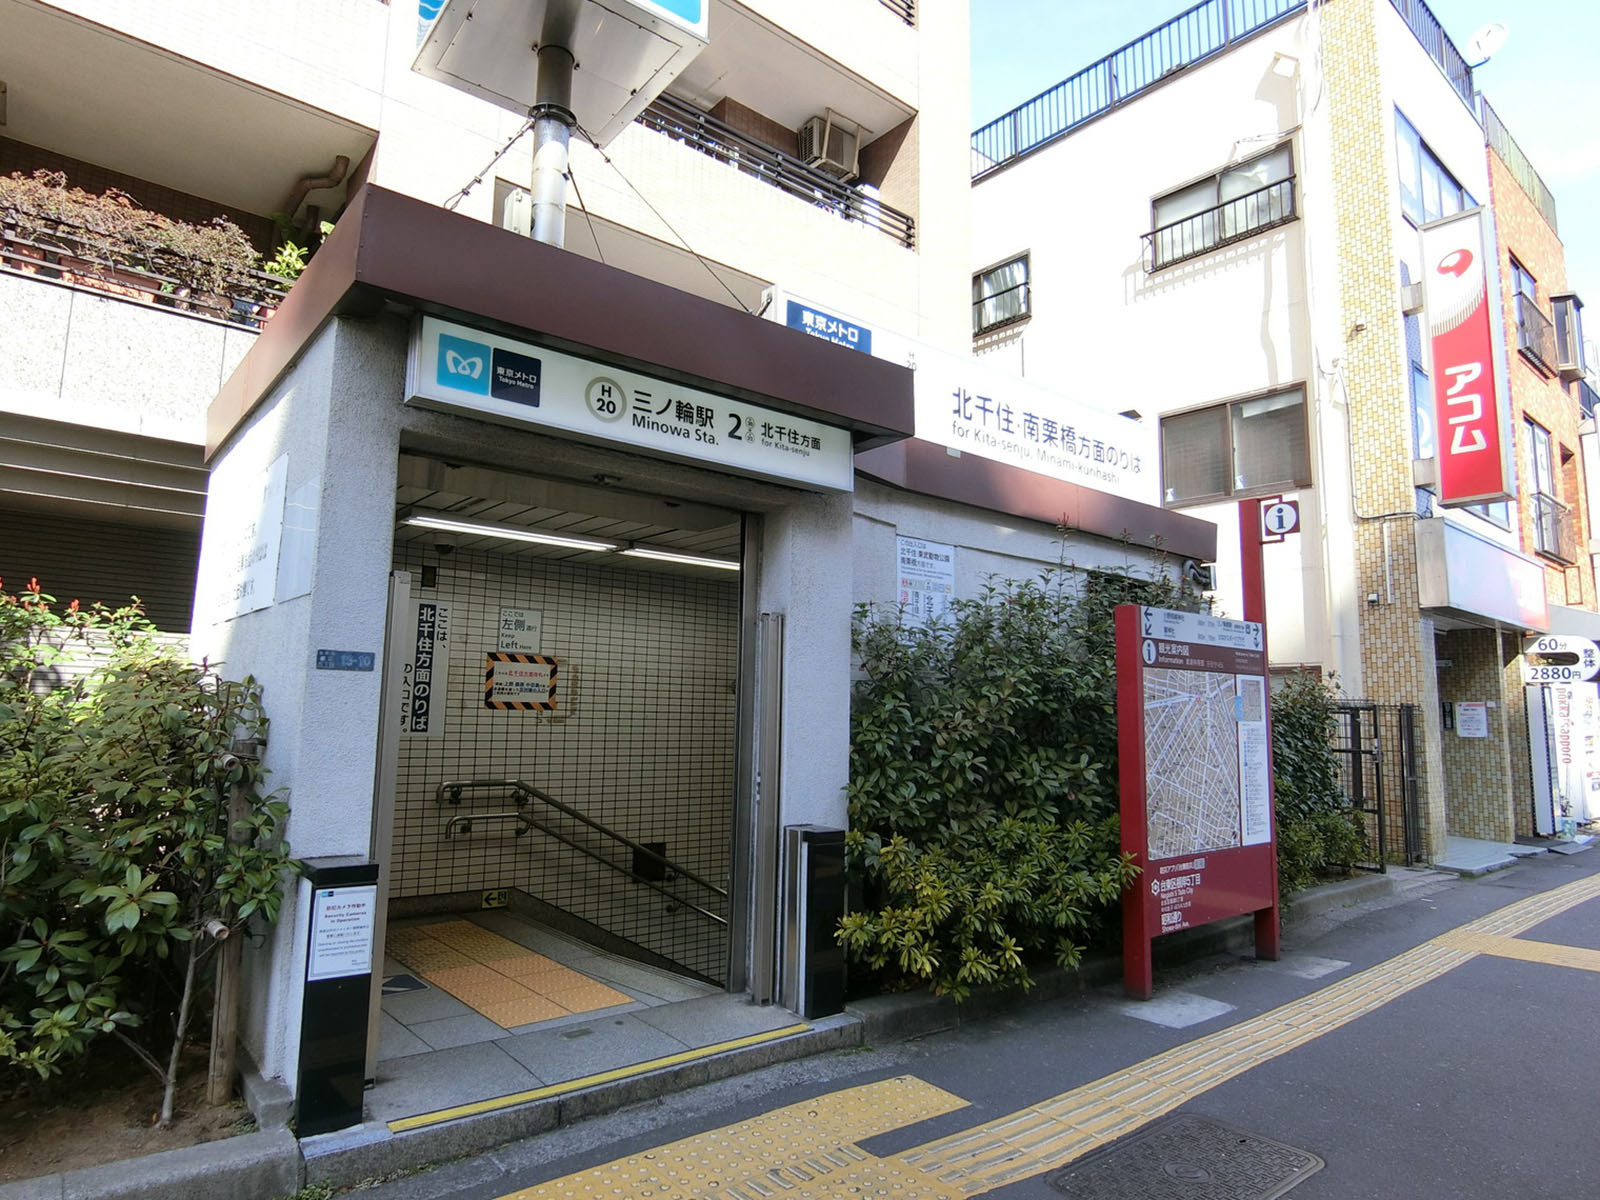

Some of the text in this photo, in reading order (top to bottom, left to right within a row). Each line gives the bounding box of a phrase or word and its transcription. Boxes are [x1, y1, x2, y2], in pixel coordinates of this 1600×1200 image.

[802, 310, 858, 343] 東京メトロ
[497, 366, 537, 383] 東京メトロ
[499, 375, 534, 389] Tokyo Metro
[601, 385, 612, 398] H
[596, 398, 616, 414] 20
[632, 390, 714, 429] 三ノ輪駅
[1445, 361, 1487, 454] アコム
[632, 413, 719, 446] Minowa Sta.
[728, 413, 742, 440] 2
[761, 422, 821, 450] 北千住方面
[952, 420, 970, 438] for
[761, 438, 810, 457] for Kita-senju
[501, 640, 519, 649] Left
[412, 606, 435, 730] 北千住方面のりば
[1530, 667, 1582, 680] 2880円
